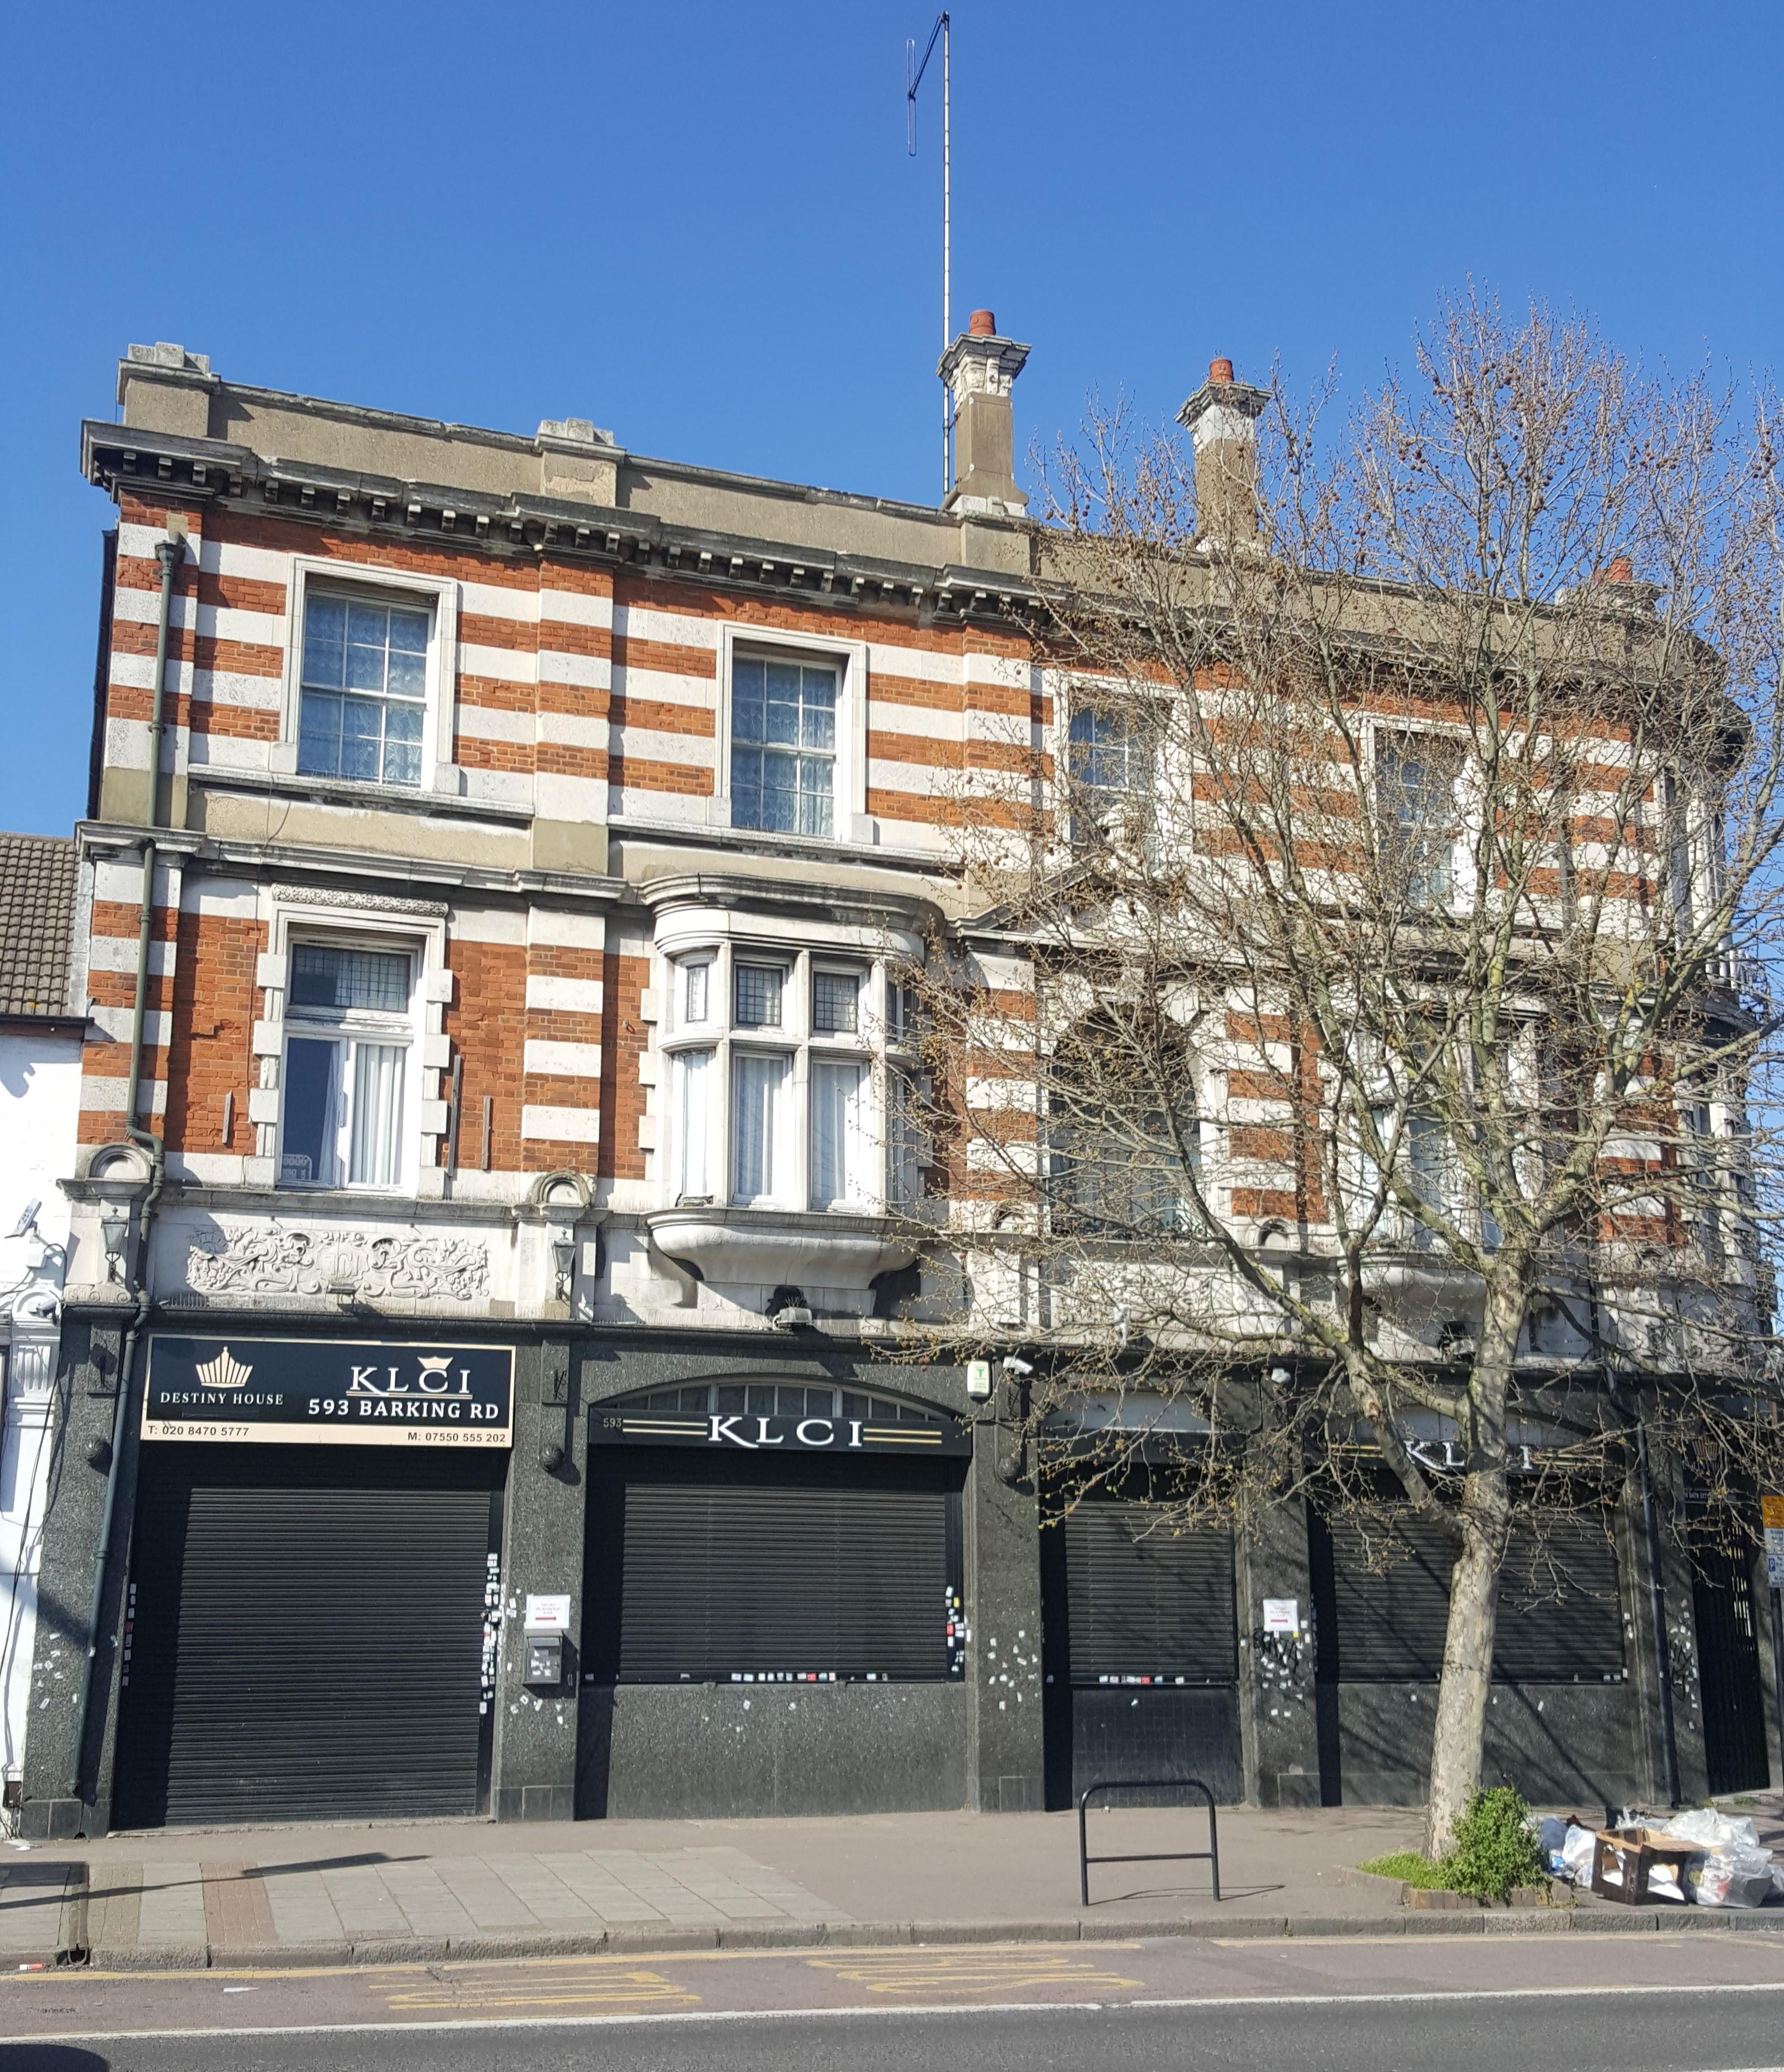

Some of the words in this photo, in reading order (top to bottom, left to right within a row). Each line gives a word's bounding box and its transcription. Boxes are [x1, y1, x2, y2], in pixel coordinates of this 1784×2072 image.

[349, 1366, 470, 1396] KLCI
[160, 1392, 227, 1403] DESTINY
[233, 1394, 284, 1405] HOUSE
[308, 1398, 349, 1415] 593
[359, 1400, 461, 1419] BARKING
[470, 1404, 499, 1419] RD
[148, 1426, 158, 1434] T:
[162, 1426, 184, 1435] 020
[188, 1427, 217, 1436] 8470
[221, 1427, 250, 1436] 5777
[603, 1417, 622, 1428] 593
[709, 1416, 862, 1448] KLCI
[408, 1432, 422, 1441] M:
[425, 1433, 459, 1442] 07550
[463, 1433, 482, 1442] 555
[486, 1433, 506, 1443] 202
[1404, 1440, 1533, 1471] KLI
[806, 1954, 1145, 1993] BUS
